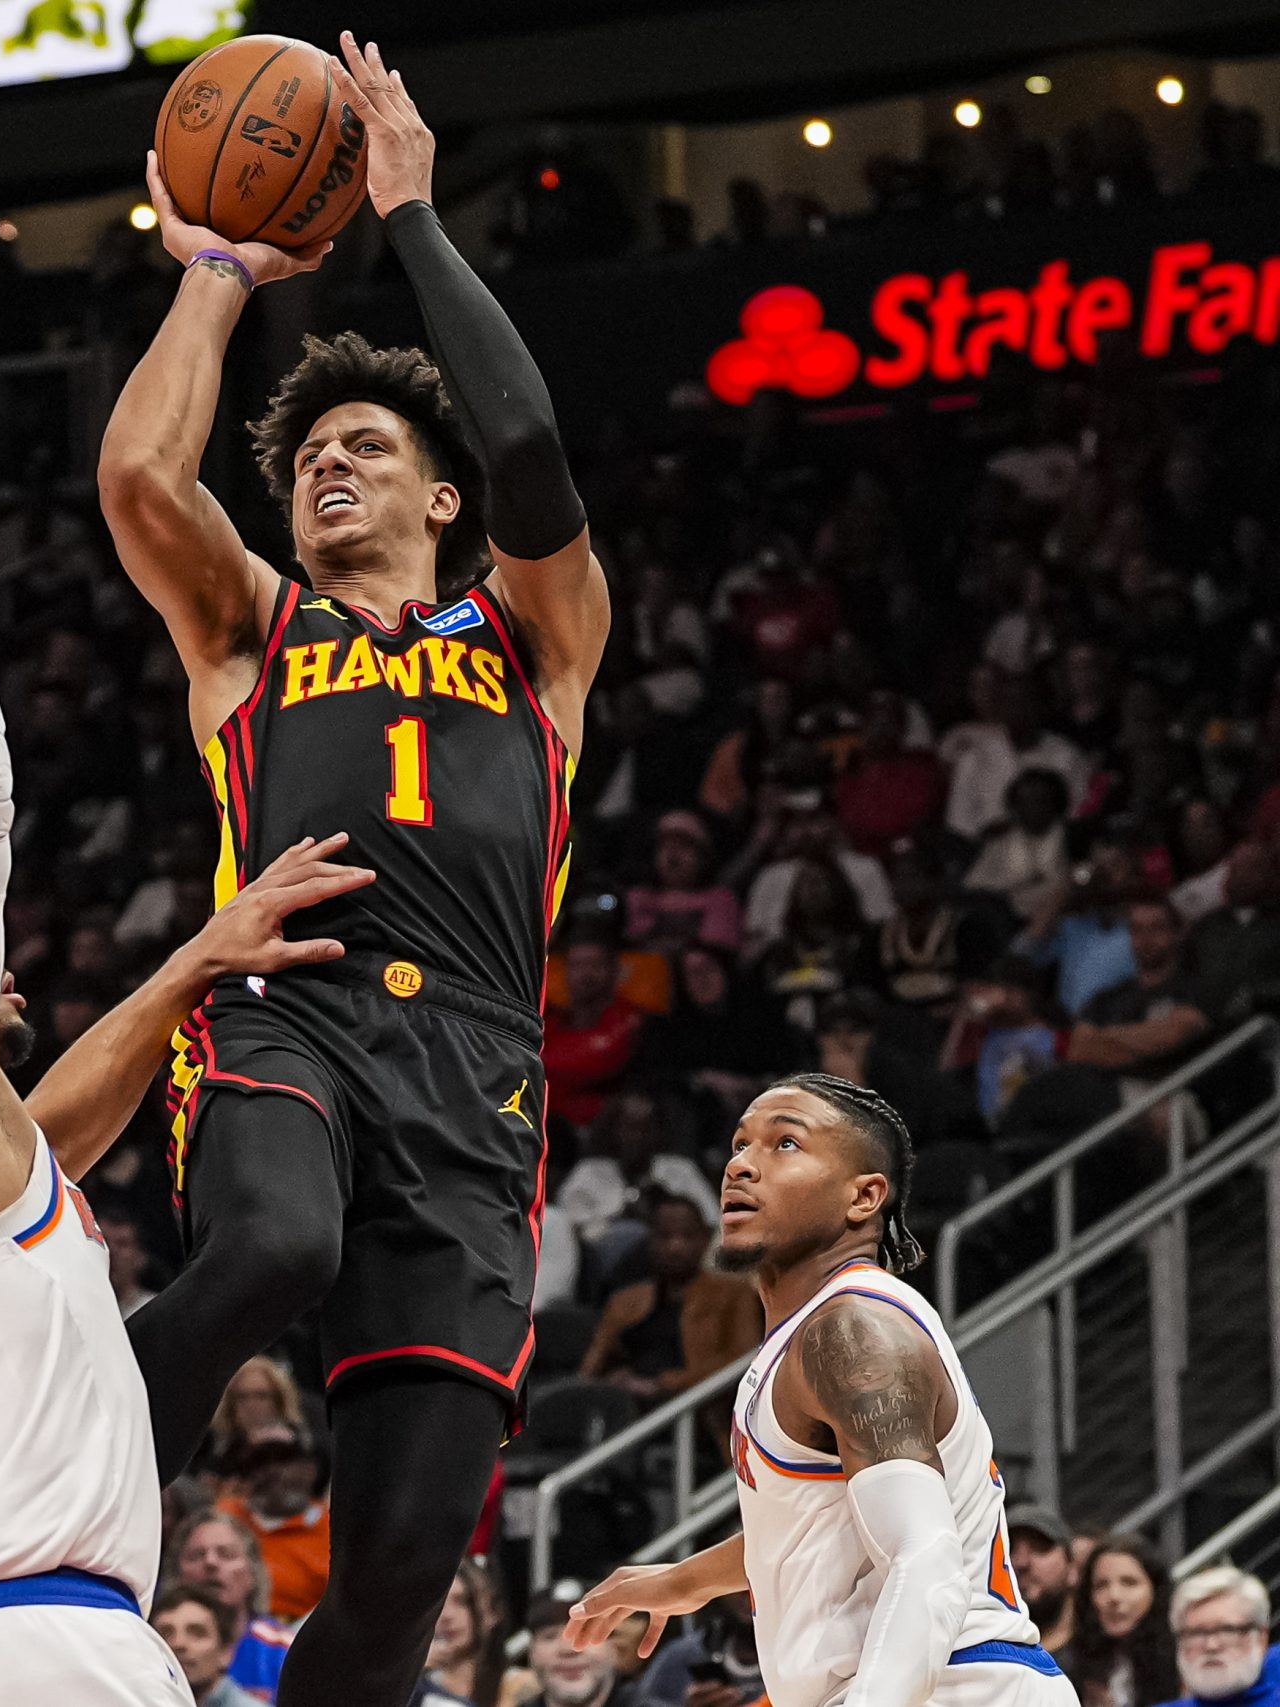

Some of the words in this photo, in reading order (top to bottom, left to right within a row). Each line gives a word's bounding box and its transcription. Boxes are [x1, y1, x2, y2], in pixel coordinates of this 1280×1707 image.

[864, 258, 1133, 389] State
[280, 632, 509, 717] HAWKS
[384, 714, 433, 827] 1
[389, 969, 416, 989] ATL
